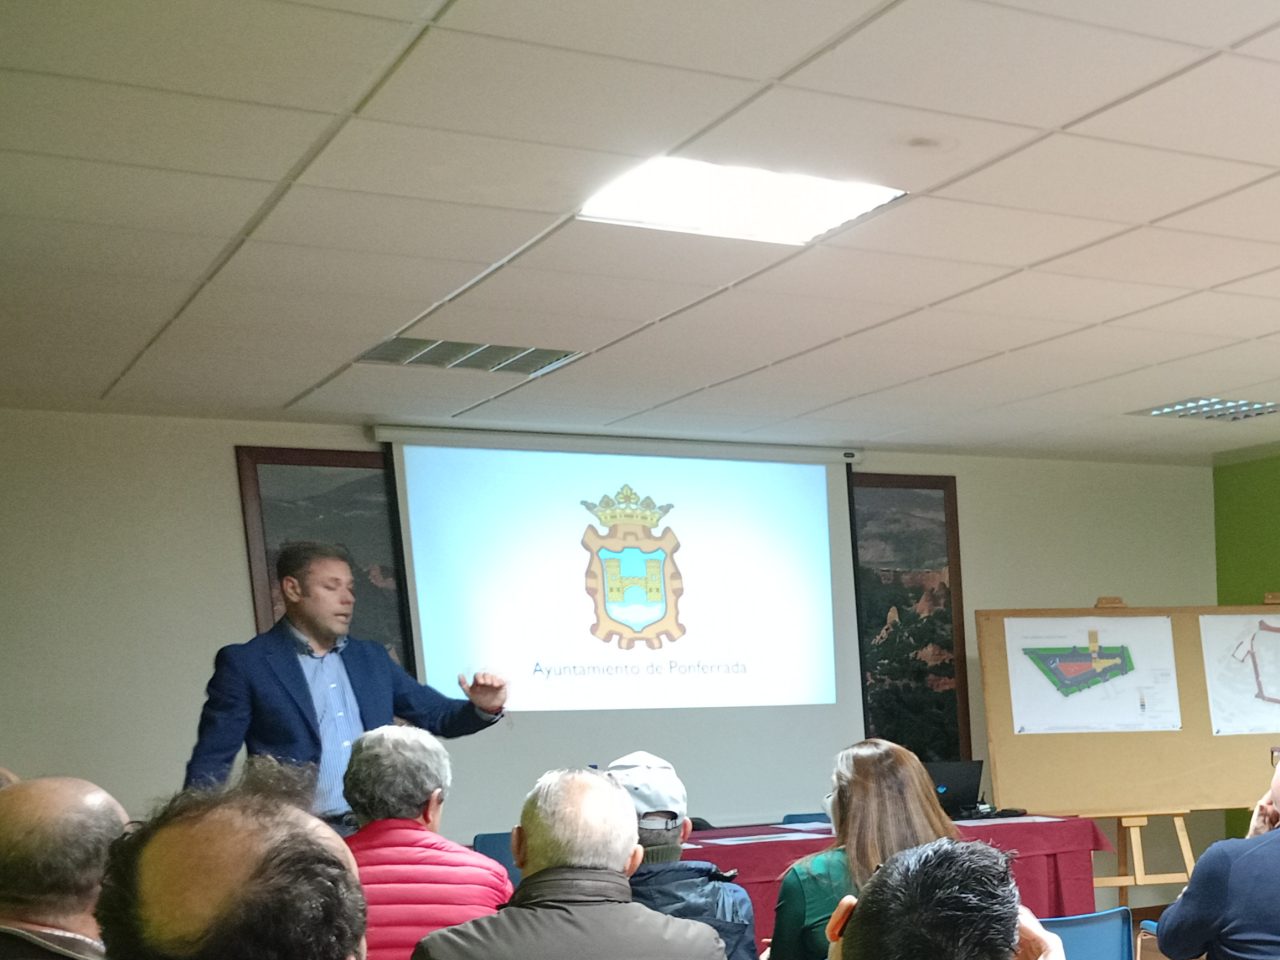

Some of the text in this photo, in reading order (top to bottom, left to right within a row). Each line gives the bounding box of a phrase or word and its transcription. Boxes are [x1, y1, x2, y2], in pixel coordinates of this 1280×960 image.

[532, 660, 747, 679] Ayuntamiento de Ponferrada
